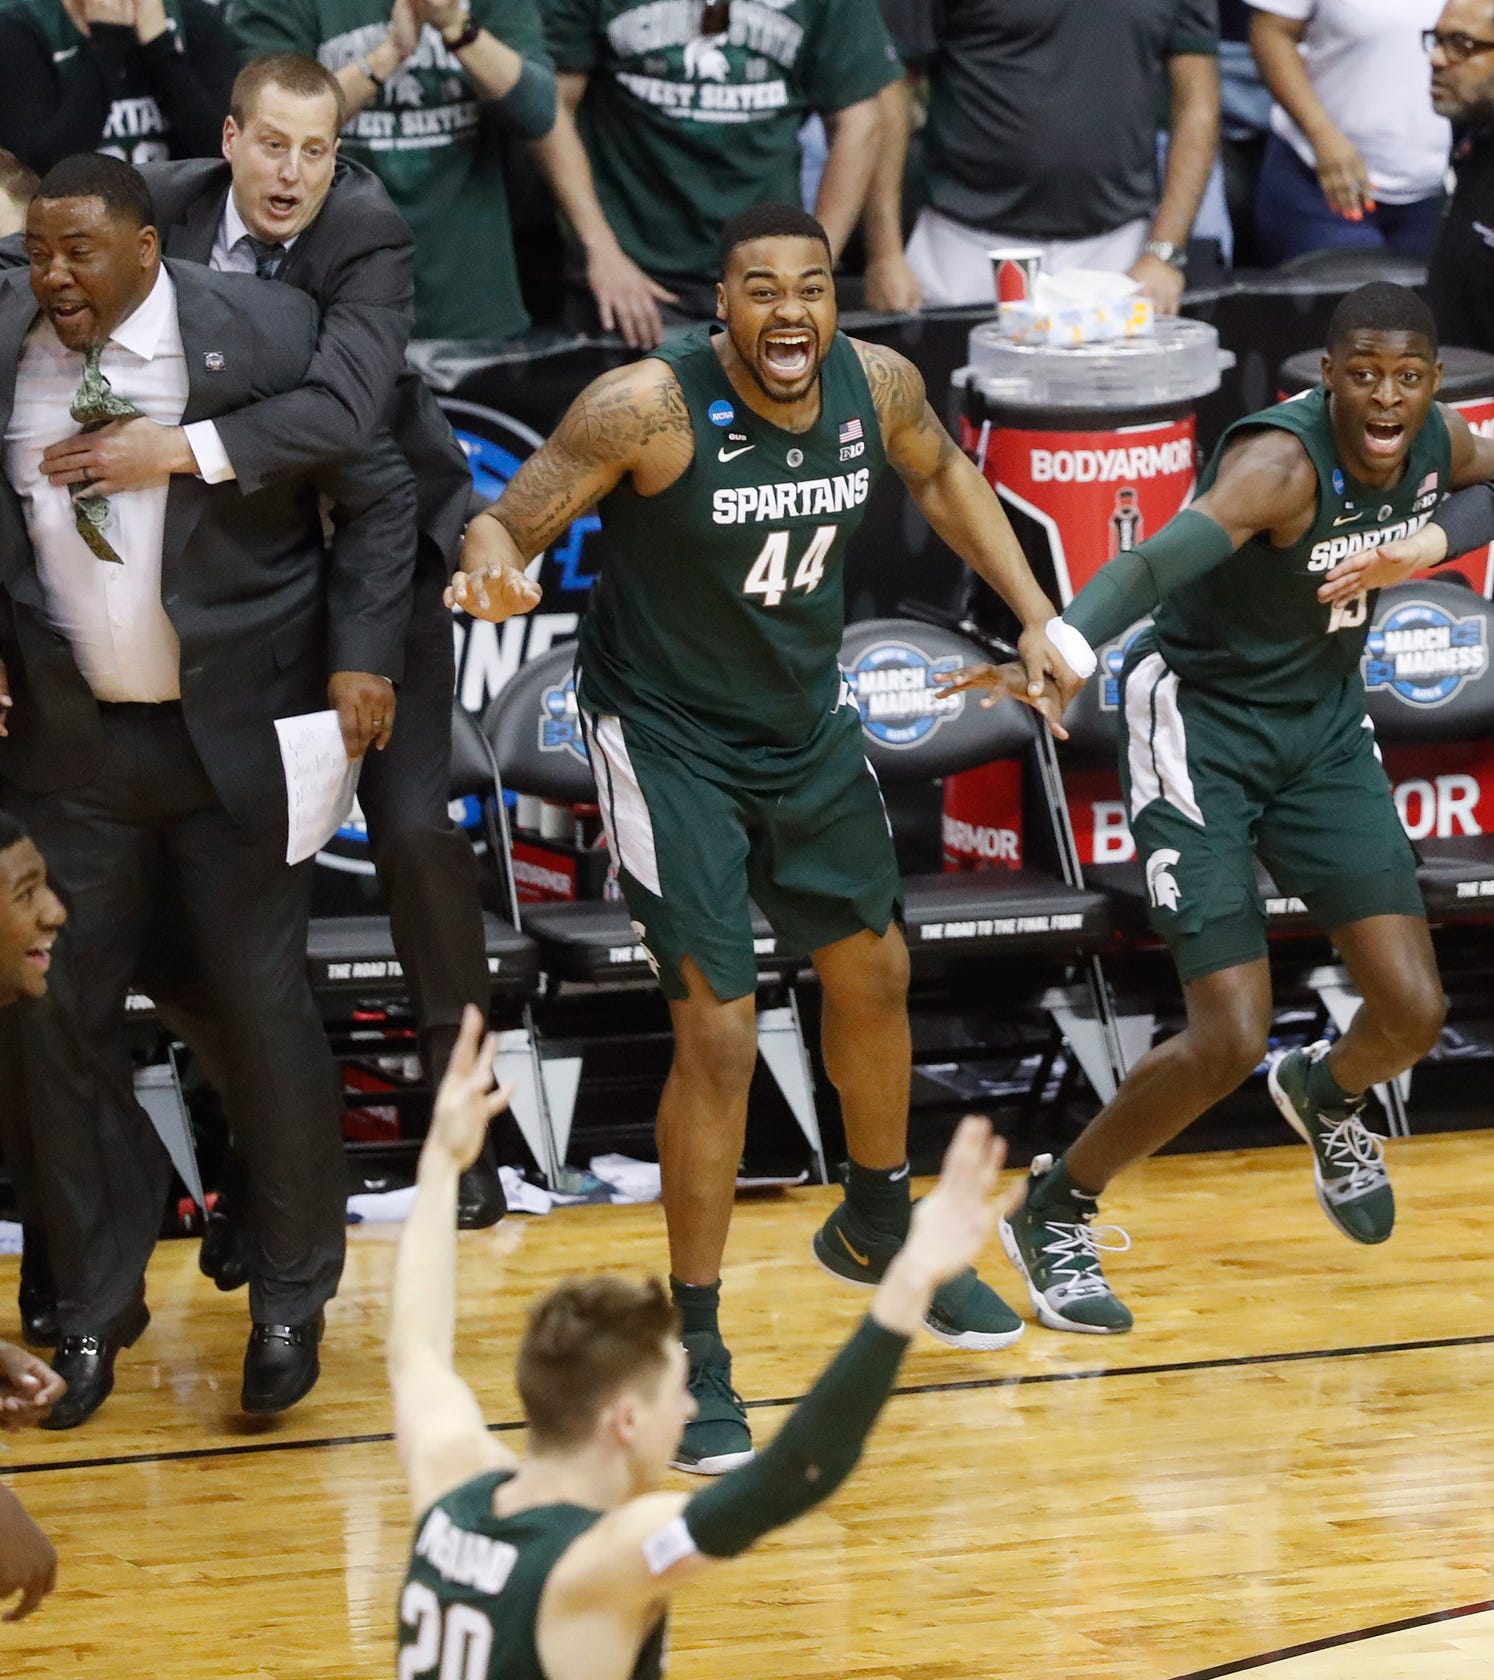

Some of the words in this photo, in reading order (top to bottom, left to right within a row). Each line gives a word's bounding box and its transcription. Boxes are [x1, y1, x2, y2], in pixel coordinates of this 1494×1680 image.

[1030, 438, 1192, 483] BODYARMOR
[711, 467, 870, 525] SPARTANS
[1307, 509, 1435, 571] SPARTA
[742, 524, 839, 607] 44
[1384, 626, 1451, 655] MARCH
[1395, 645, 1484, 675] MADNESS
[858, 666, 926, 695] MARCH
